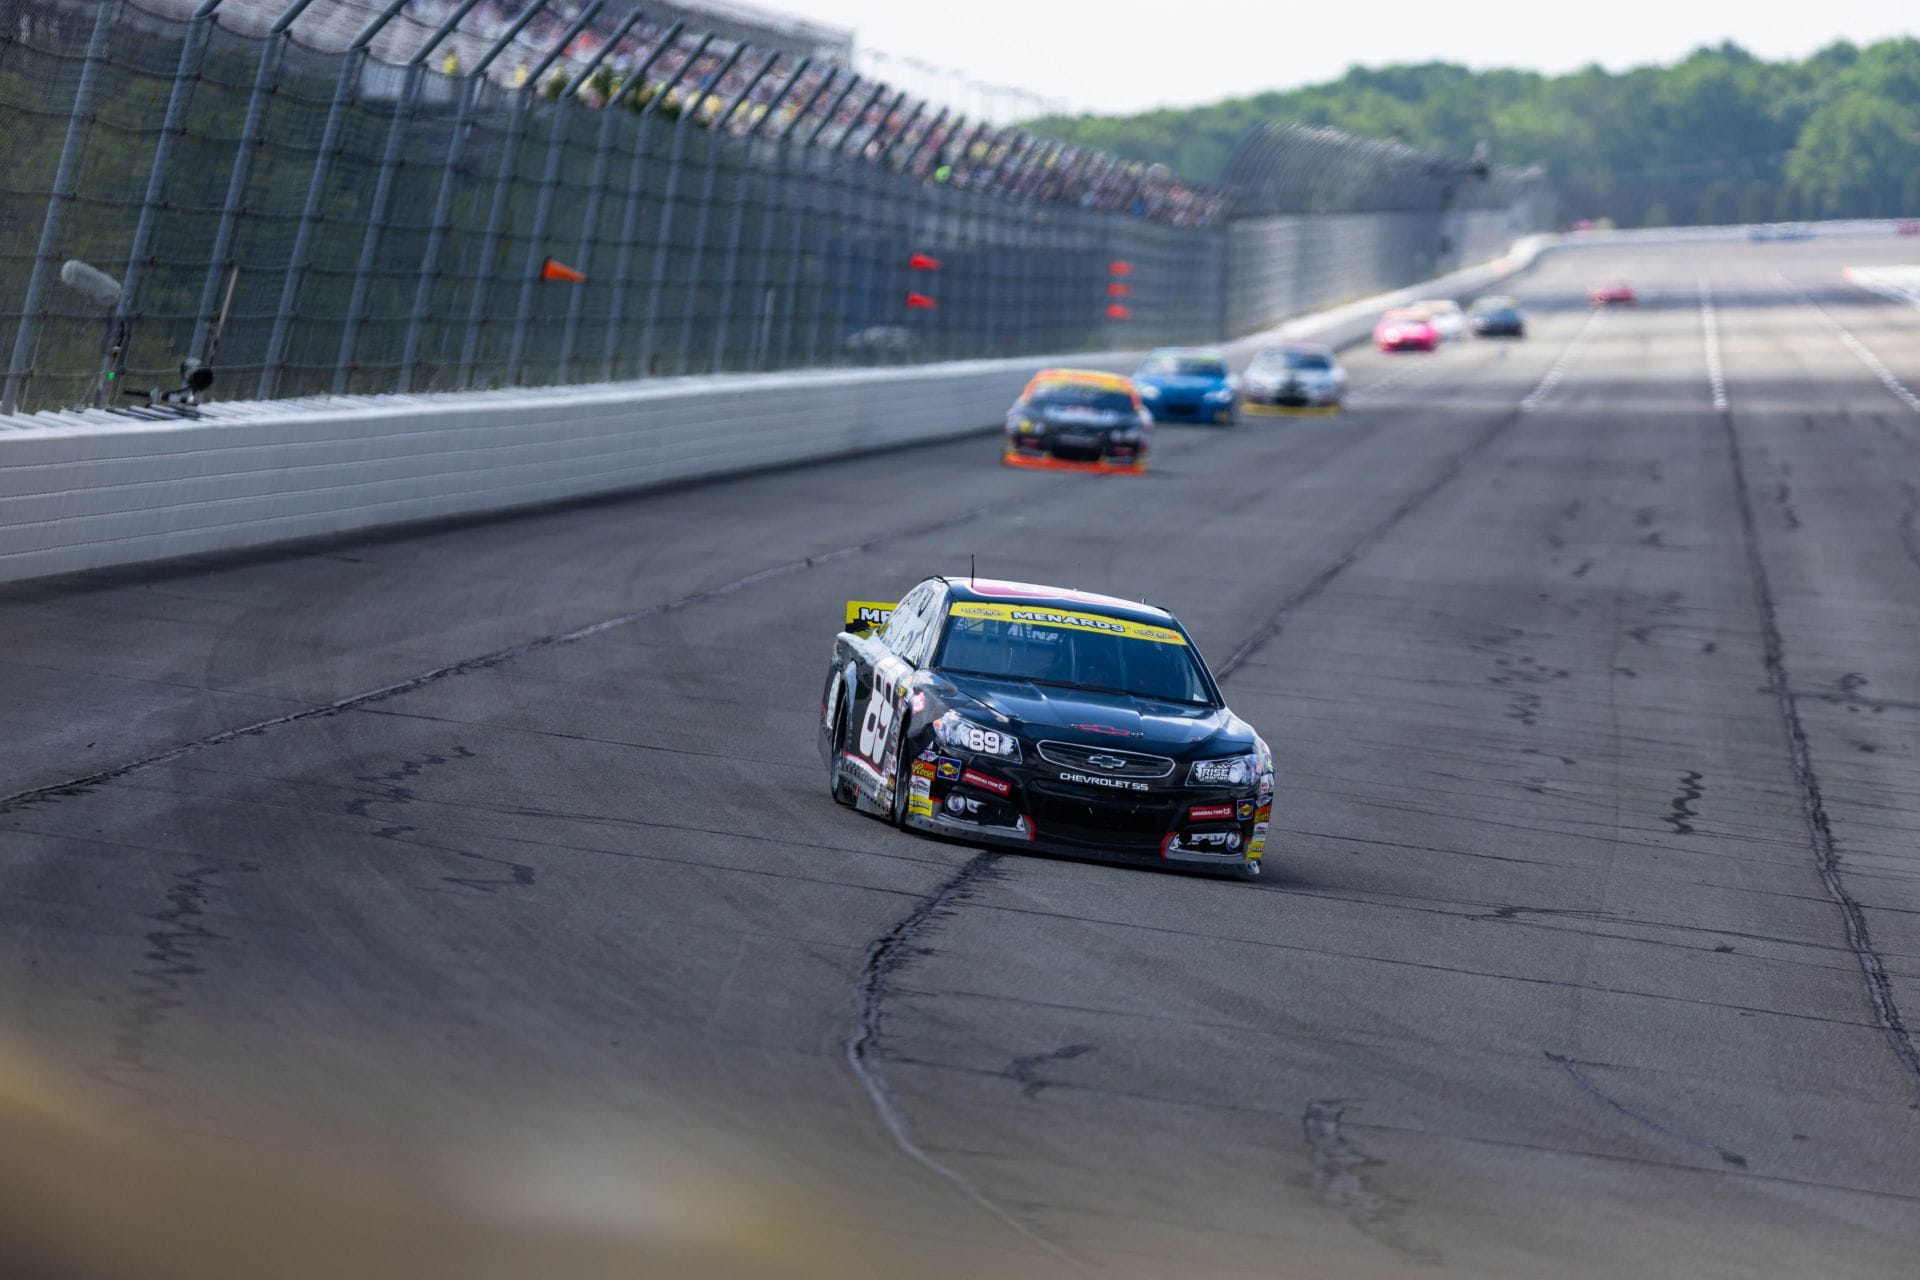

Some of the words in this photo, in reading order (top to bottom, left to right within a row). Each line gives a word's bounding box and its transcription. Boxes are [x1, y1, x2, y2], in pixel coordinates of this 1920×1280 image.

[1011, 611, 1125, 632] MENARDS
[969, 729, 1000, 754] 89
[1060, 772, 1131, 789] CHEVROLET
[1132, 782, 1149, 791] SS
[1202, 768, 1229, 777] RISE
